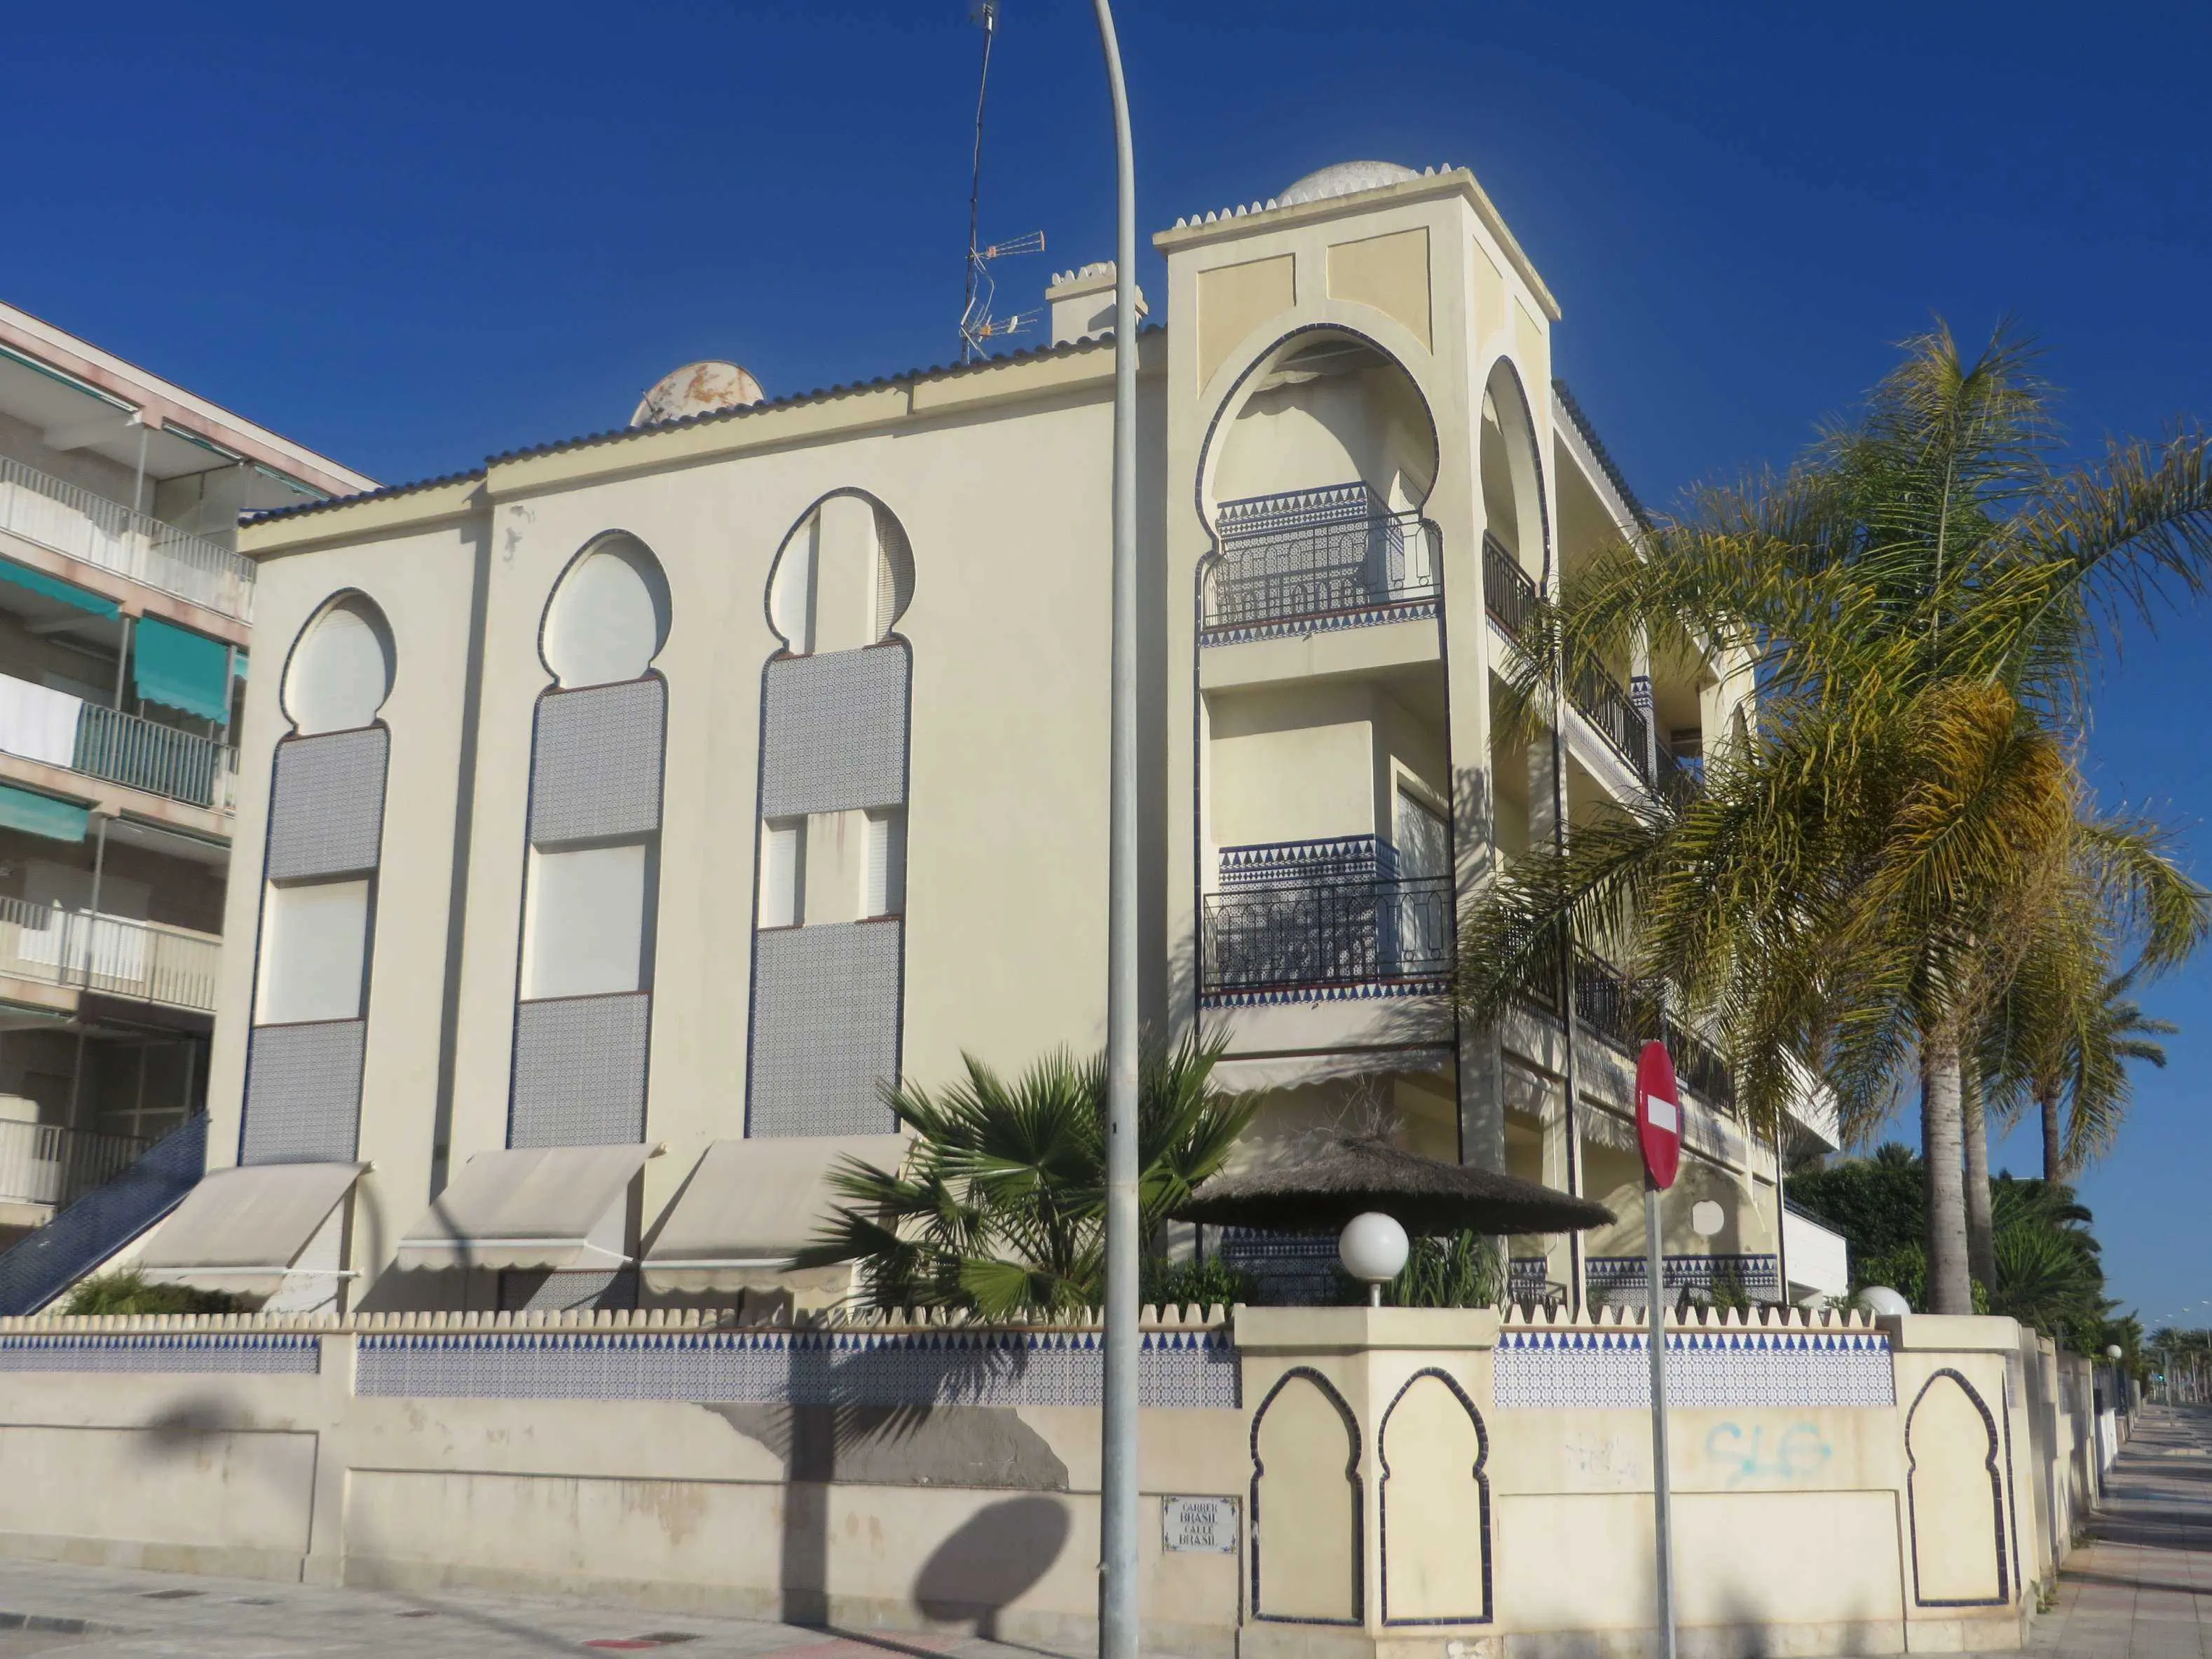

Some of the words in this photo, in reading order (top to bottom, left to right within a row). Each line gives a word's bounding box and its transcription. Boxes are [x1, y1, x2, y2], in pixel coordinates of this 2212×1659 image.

[1183, 1503, 1217, 1513] CARRER
[1180, 1512, 1217, 1523] BRASIL
[1184, 1525, 1213, 1534] CALLE
[1179, 1534, 1218, 1545] BRASIL
